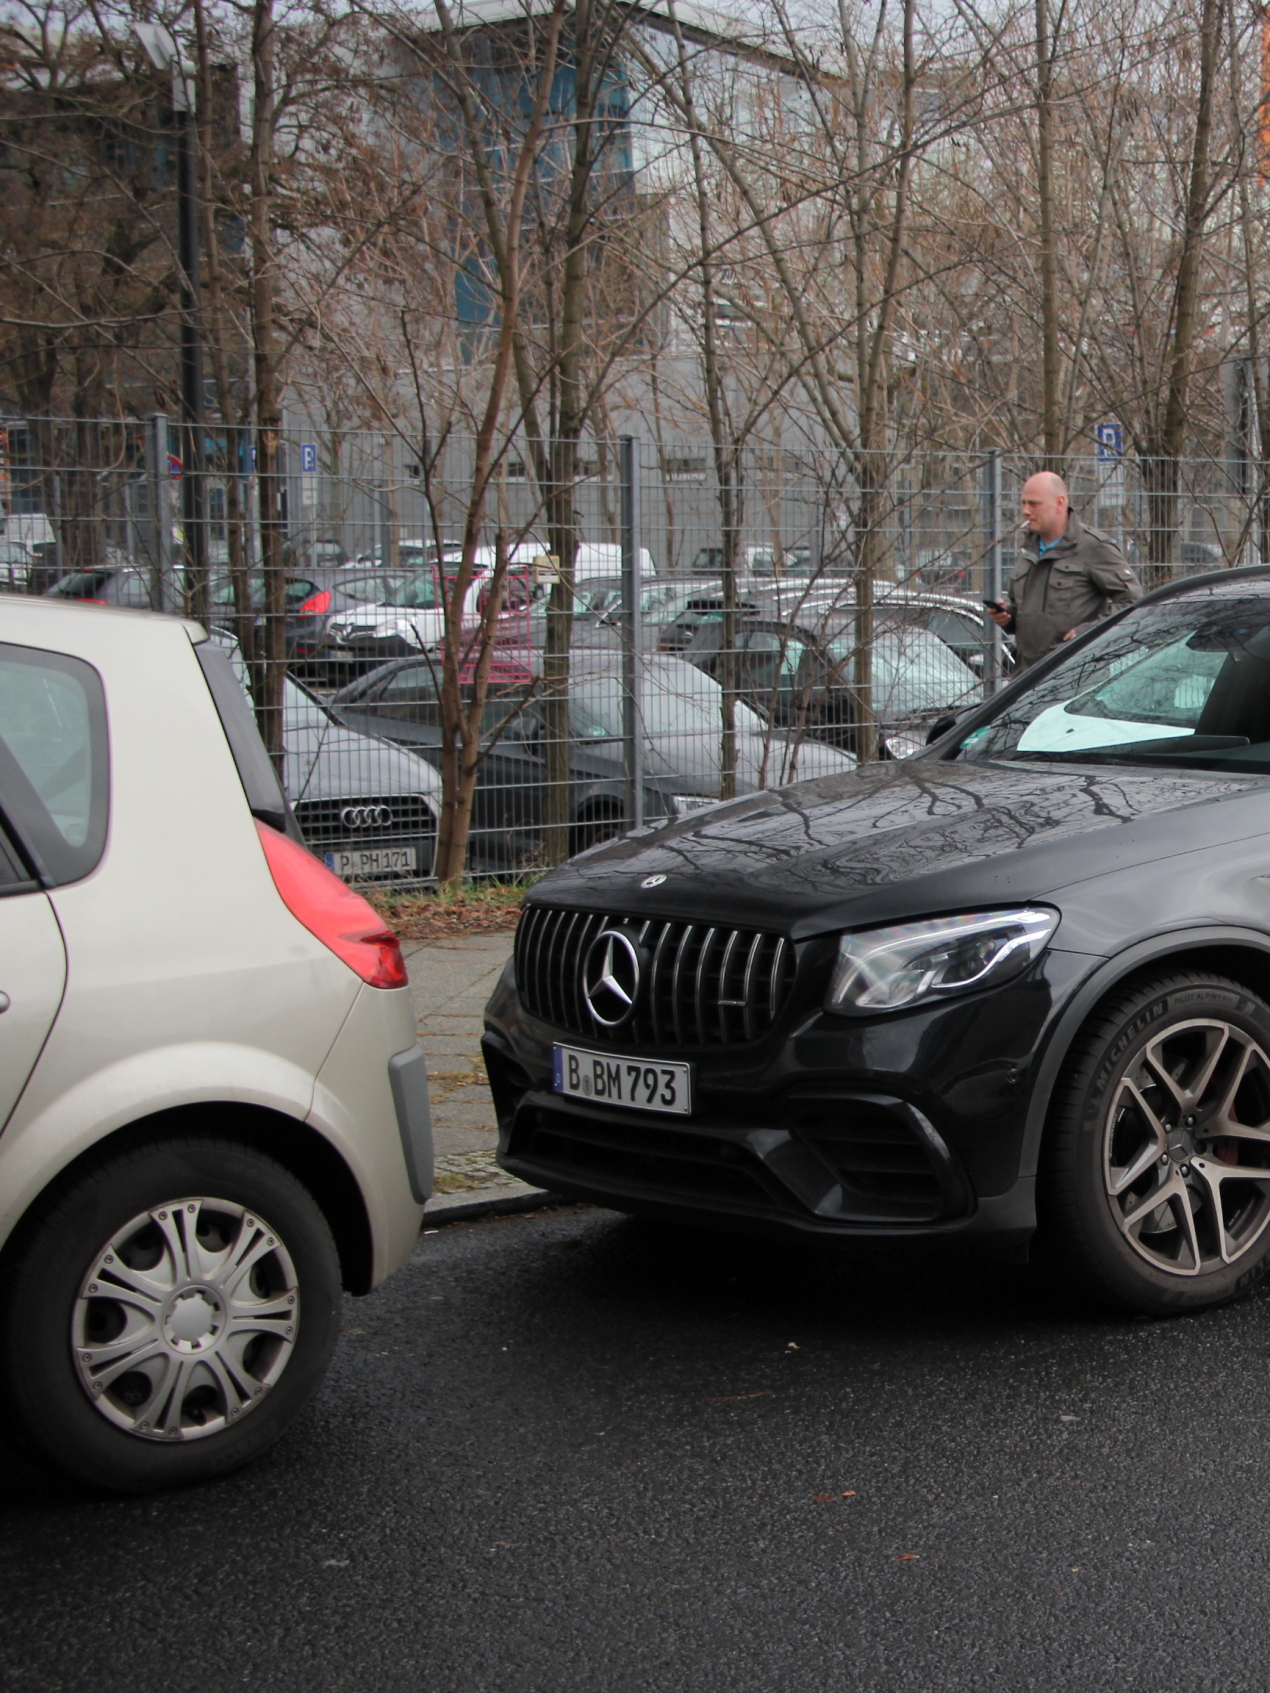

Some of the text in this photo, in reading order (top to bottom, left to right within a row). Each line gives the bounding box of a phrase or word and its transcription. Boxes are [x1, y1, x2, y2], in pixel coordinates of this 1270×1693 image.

[304, 447, 314, 469] P
[384, 851, 410, 868] 171
[1174, 994, 1193, 1004] PILOT
[1096, 1002, 1163, 1092] MICHELIN
[568, 1054, 676, 1106] B BM 793
